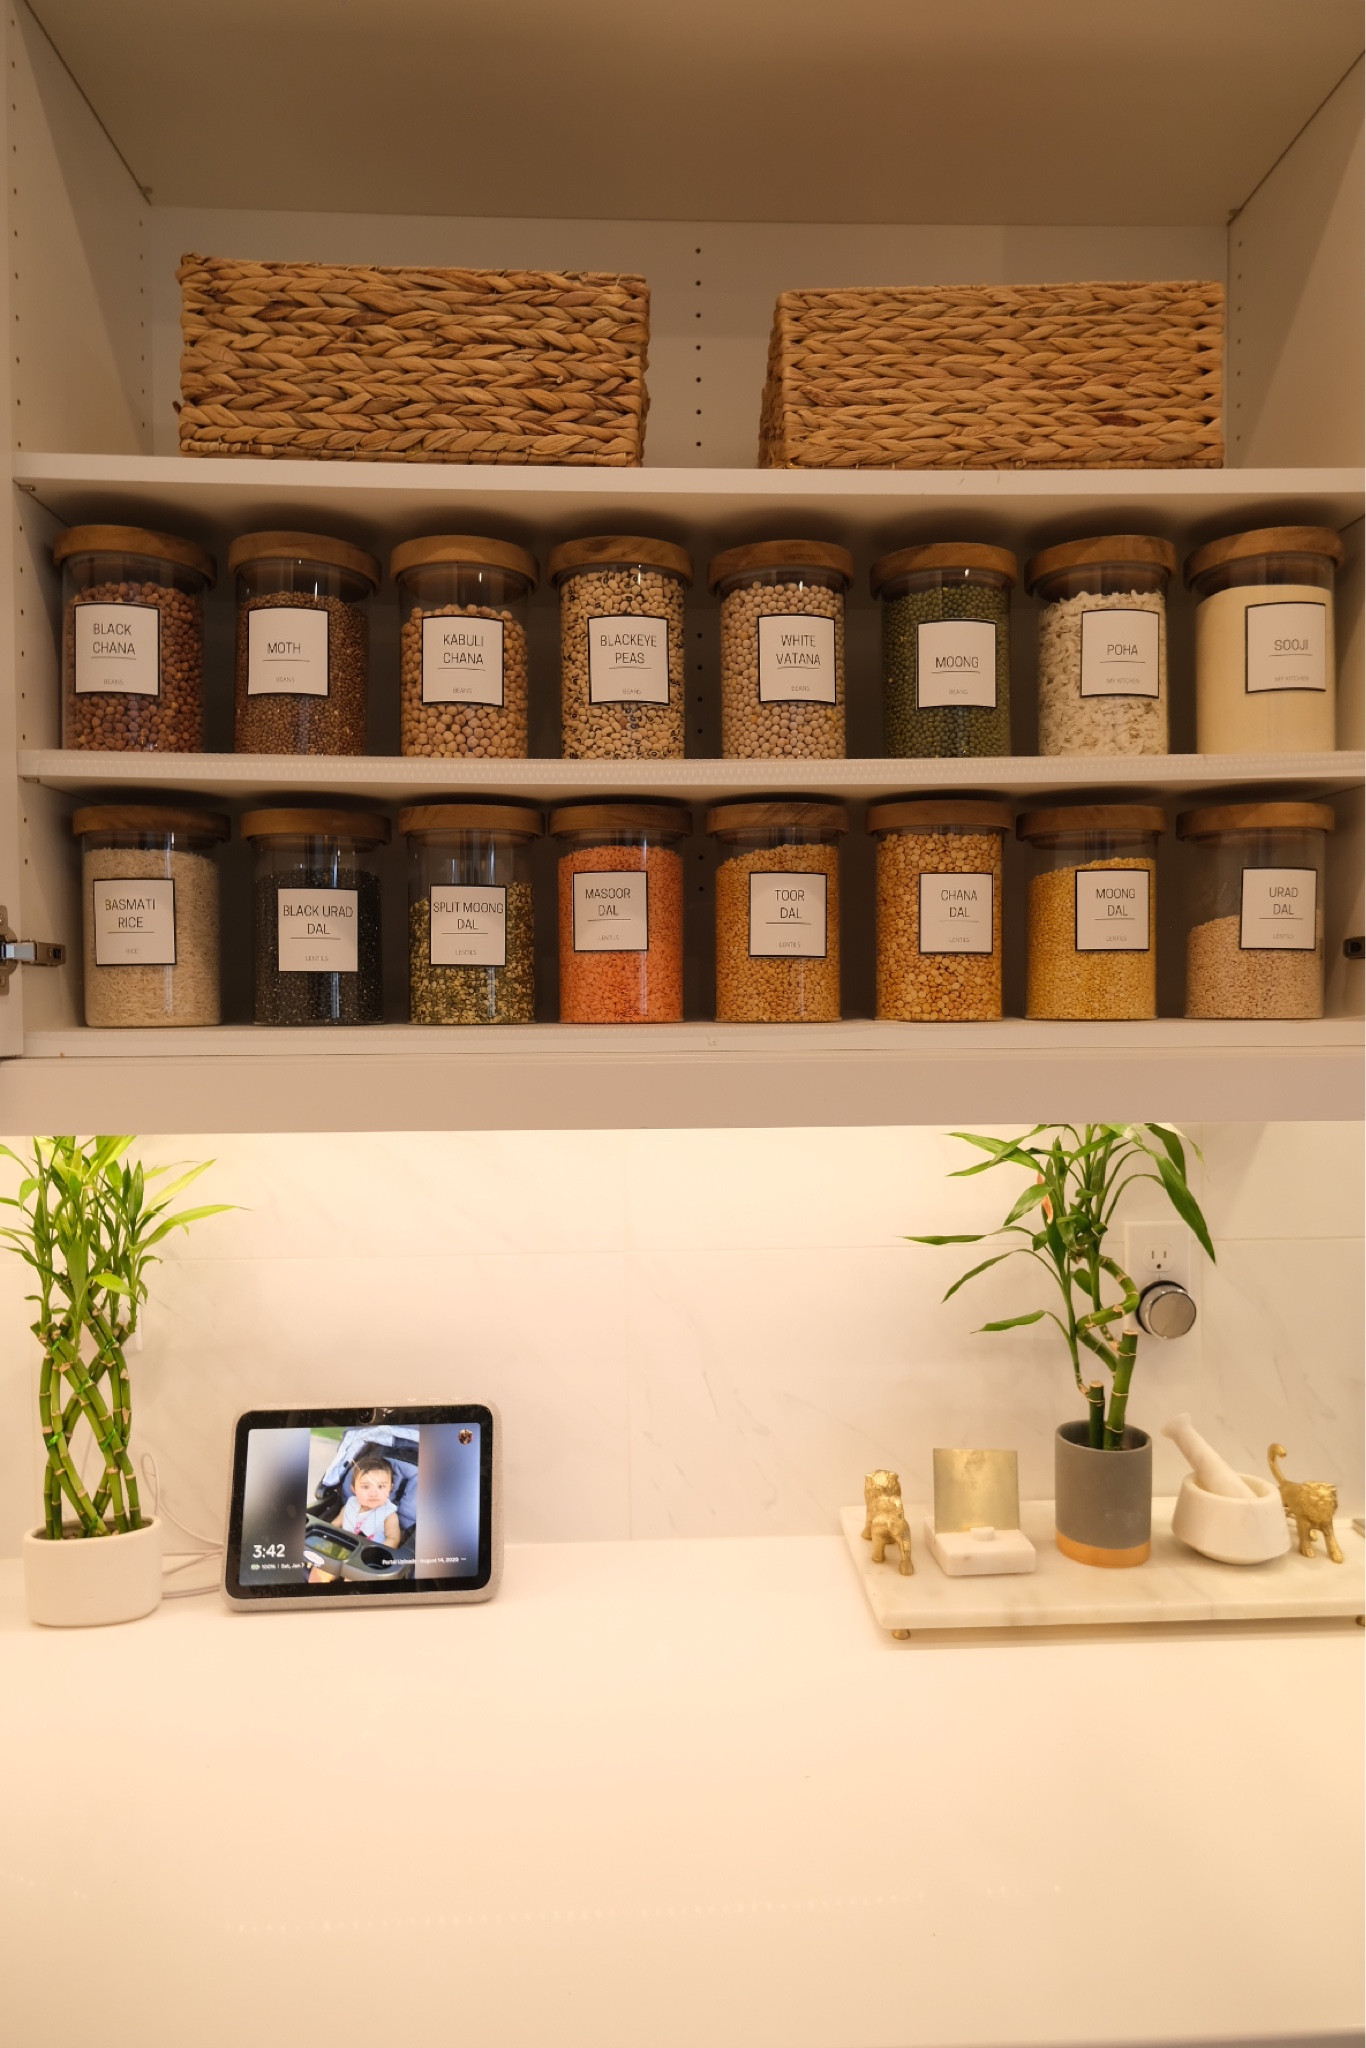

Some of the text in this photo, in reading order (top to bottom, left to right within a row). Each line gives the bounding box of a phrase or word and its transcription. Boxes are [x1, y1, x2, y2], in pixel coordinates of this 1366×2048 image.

[93, 623, 132, 636] BLACK
[443, 633, 484, 646] KABULI
[600, 634, 657, 648] BLACKEYE
[781, 634, 816, 648] WHITE
[1274, 638, 1308, 651] SOOJI
[92, 641, 136, 654] CHANA
[267, 642, 301, 654] MOTH
[1106, 644, 1139, 656] POHA
[443, 652, 484, 664] CHANA
[615, 652, 646, 664] PEAS
[776, 652, 821, 666] VATANA
[935, 656, 979, 669] MOONG
[585, 887, 631, 900] MASOOR
[774, 888, 805, 902] TOOR
[941, 888, 977, 902] CHANA
[1096, 887, 1135, 900] MOONG
[1269, 886, 1298, 898] URAD
[104, 898, 156, 912] BASMATI
[283, 904, 353, 918] BLACK URAD
[433, 901, 503, 914] SPLIT MOONG
[598, 904, 619, 916] DAL
[1108, 904, 1128, 917] DAL
[1273, 902, 1294, 915] DAL
[780, 906, 802, 919] DAL
[950, 906, 970, 918] DAL
[117, 916, 144, 928] RICE
[456, 918, 479, 930] DAL
[307, 922, 330, 936] DAL
[253, 1544, 285, 1559] 3:42
